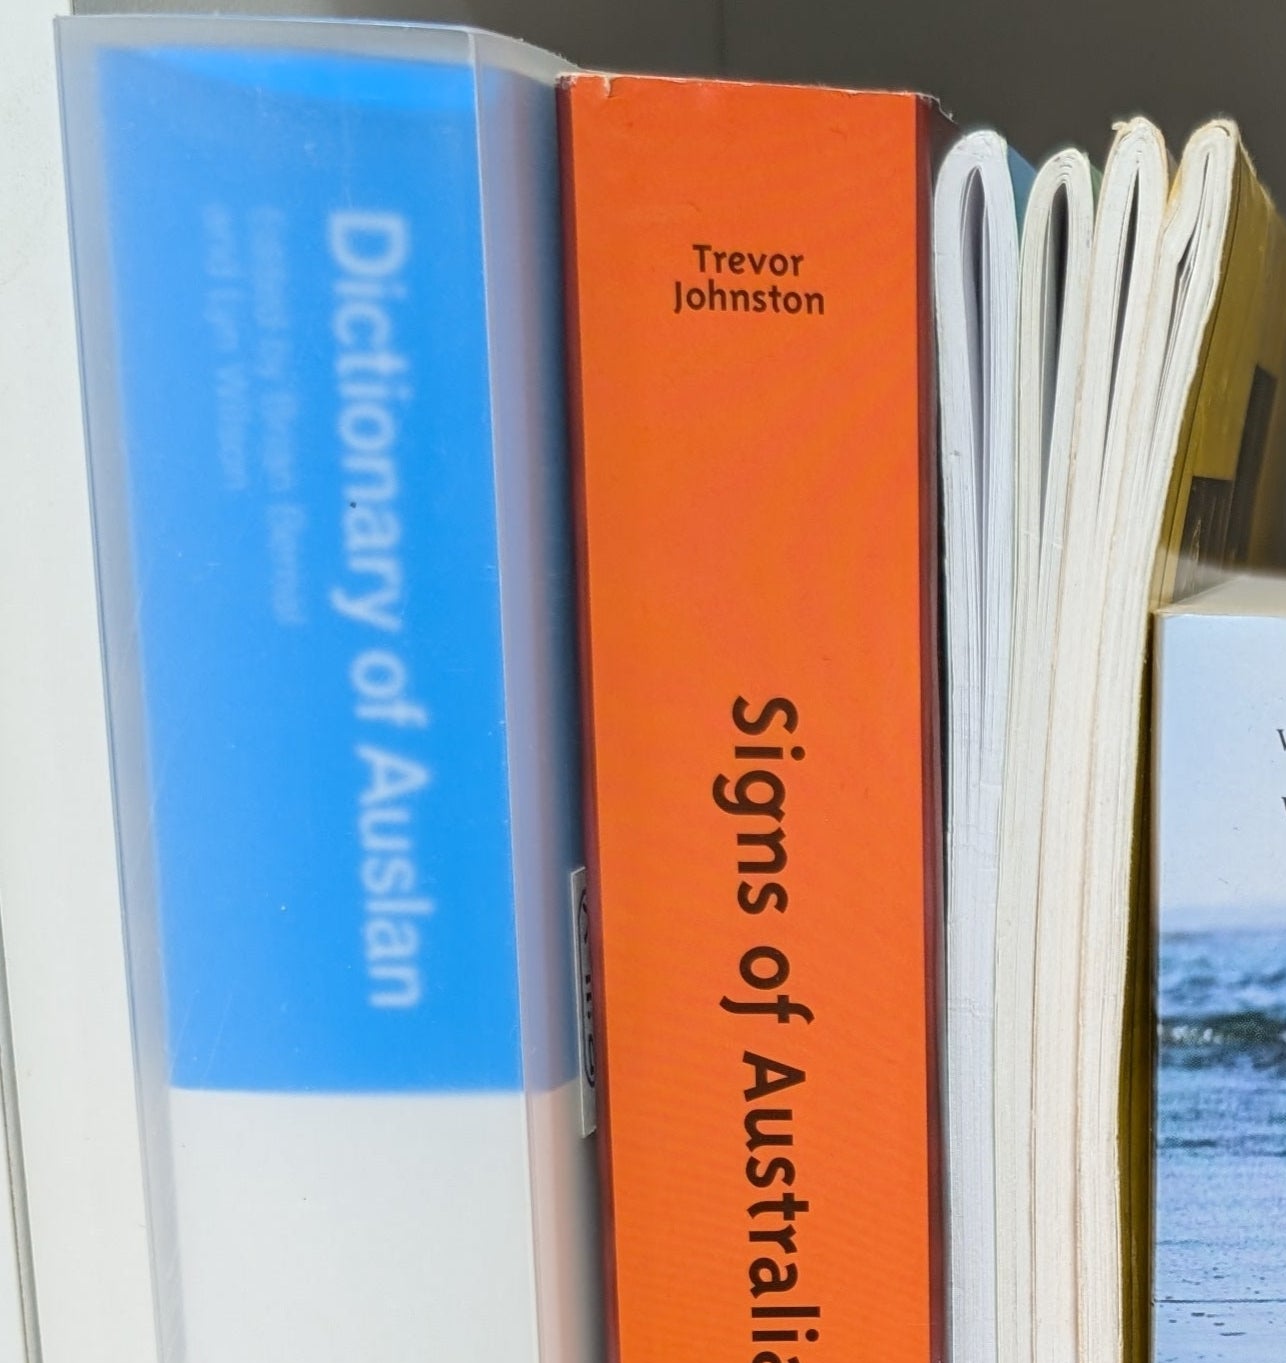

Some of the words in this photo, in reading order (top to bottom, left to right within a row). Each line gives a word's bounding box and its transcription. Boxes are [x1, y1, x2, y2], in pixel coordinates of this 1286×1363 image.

[673, 278, 825, 315] Johnston
[692, 244, 804, 277] Trevor
[327, 207, 412, 632] Dictionary
[348, 645, 430, 731] of
[711, 694, 806, 916] Signs
[354, 740, 435, 1011] Auslan
[719, 943, 815, 1024] of
